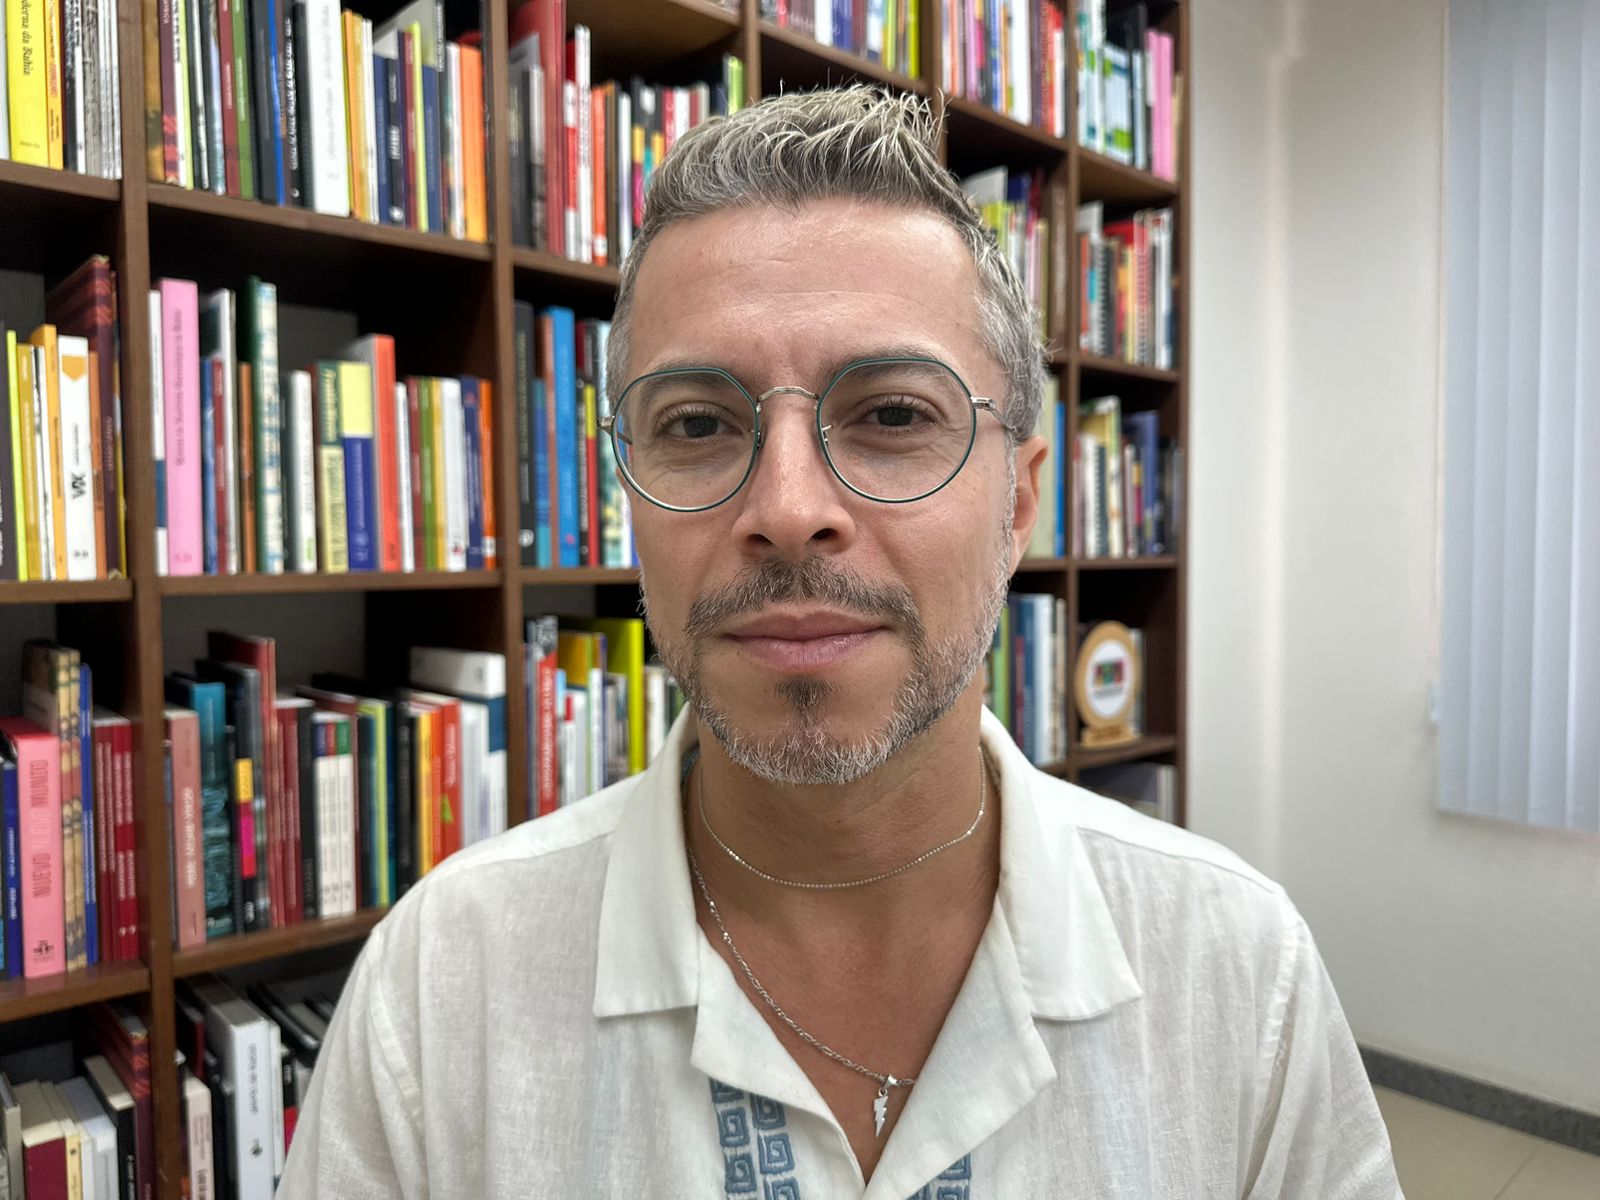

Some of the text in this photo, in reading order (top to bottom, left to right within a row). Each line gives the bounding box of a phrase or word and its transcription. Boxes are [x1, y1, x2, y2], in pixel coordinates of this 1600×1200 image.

[21, 0, 34, 76] derna da Bahia
[29, 759, 49, 808] MUNDO
[32, 853, 51, 898] NUEVO
